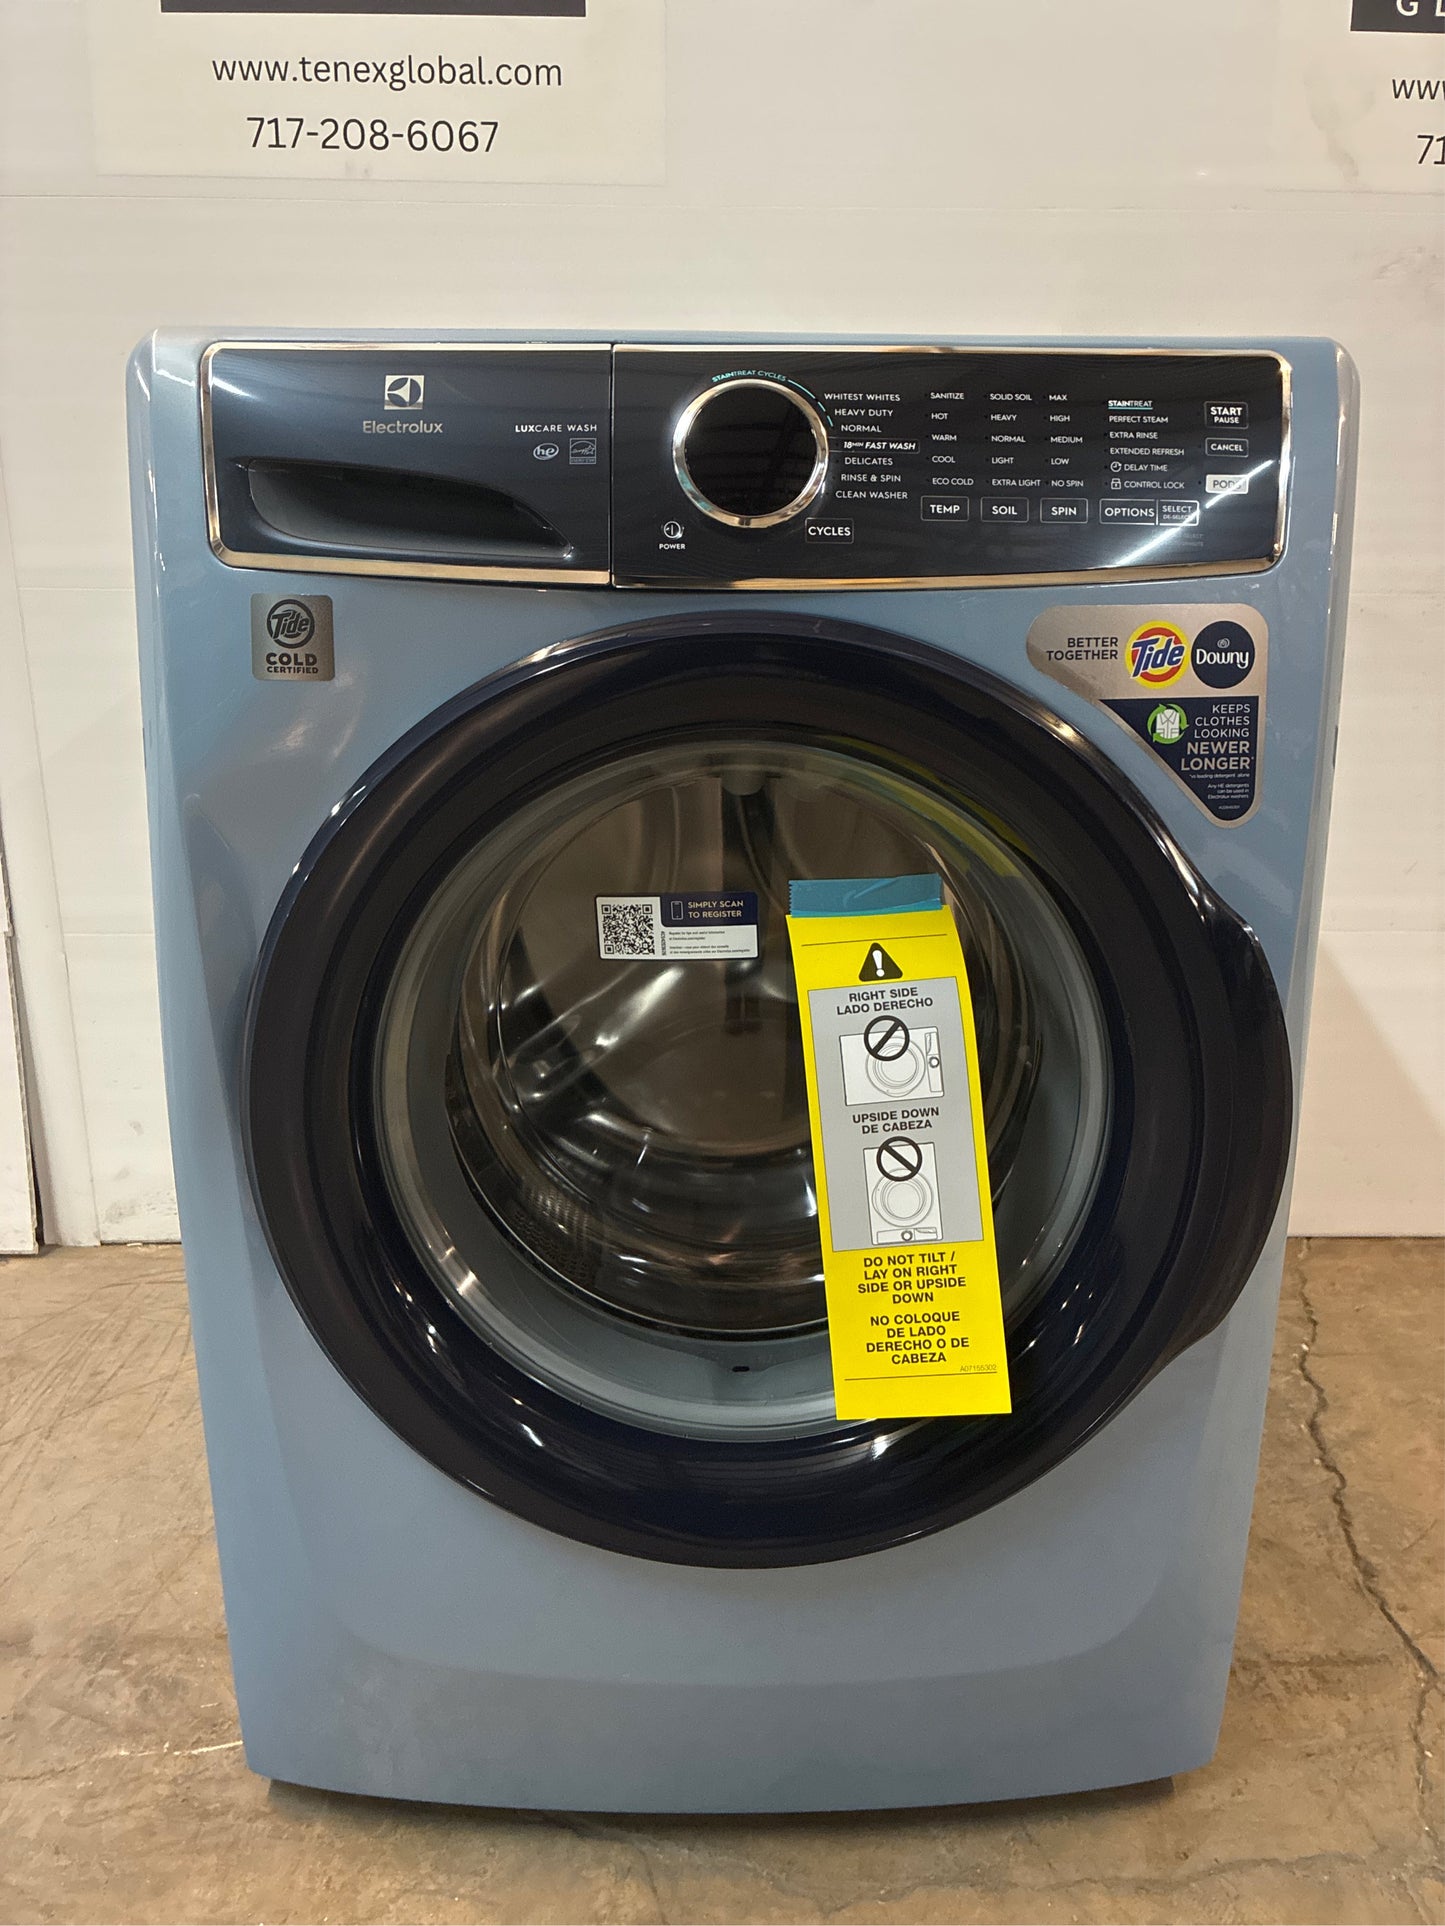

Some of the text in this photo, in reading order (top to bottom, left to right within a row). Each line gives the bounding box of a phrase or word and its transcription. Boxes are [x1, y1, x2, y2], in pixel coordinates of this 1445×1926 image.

[212, 55, 563, 91] www.tenexglobal.com
[1392, 79, 1445, 100] ww
[246, 116, 499, 153] 717-208-6067
[712, 370, 787, 382] STAINTREAT CYCLES
[824, 393, 901, 402] WHITEST WHITES
[930, 392, 965, 400] SANITIZE
[990, 393, 1032, 401] SOLID SOIL
[834, 408, 894, 417] HEAVY DUTY
[1210, 406, 1243, 416] START
[990, 414, 1017, 422] HEAVY
[1050, 414, 1070, 422] HIGH
[1109, 415, 1169, 424] PERFECT STEAM
[1214, 416, 1240, 424] PAUSE
[363, 420, 443, 434] Electrolux
[515, 424, 597, 433] LUXCARE WASH
[841, 424, 882, 433] NORMAL
[991, 435, 1026, 443] NORMAL
[1050, 435, 1083, 443] MEDIUM
[1109, 431, 1159, 440] EXTRA RINSE
[865, 441, 887, 449] FAST
[889, 442, 916, 450] WASH
[1210, 443, 1243, 452] CANCEL
[1110, 447, 1185, 456] EXTENDED REFRESH
[844, 457, 893, 466] DELICATES
[931, 455, 956, 463] COOL
[991, 456, 1014, 465] LIGHT
[1051, 457, 1069, 465] LOW
[1124, 463, 1168, 472] DELAY TIME
[841, 474, 869, 482] RINSE
[879, 474, 901, 482] SPIN
[932, 477, 974, 486] ECO COLD
[1017, 479, 1041, 487] LIGHT
[1051, 479, 1084, 488] NO SPIN
[1124, 480, 1185, 489] CONTROL LOCK
[835, 490, 908, 500] CLEAN WASHER
[930, 504, 960, 514] TEMP
[992, 505, 1018, 515] SOIL
[1051, 506, 1077, 516] SPIN
[1104, 507, 1155, 517] OPTIONS
[1162, 505, 1192, 513] SELECT
[808, 526, 851, 537] CYCLES
[271, 609, 311, 640] Tide
[1067, 637, 1119, 648] BETTER
[266, 652, 318, 666] COLD
[1046, 650, 1118, 661] TOGETHER
[1130, 636, 1185, 679] Tide
[1196, 649, 1249, 669] Downy
[267, 666, 319, 674] CERTIFIED
[1212, 704, 1250, 714] KEEPS
[1195, 716, 1250, 726] CLOTHES
[1194, 728, 1250, 739] LOOKING
[1187, 741, 1250, 755] NEWER
[688, 900, 744, 909] SIMPLY SCAN
[688, 910, 742, 919] TO REGISTER
[849, 987, 918, 1002] RIGHT SIDE
[837, 997, 933, 1015] LADO DERECHO
[852, 1107, 939, 1124] UPSIDE DOWN
[862, 1119, 932, 1135] DE CABEZA
[864, 1251, 956, 1268] DO NOT TILT /
[864, 1264, 957, 1281] LAY ON RIGHT
[857, 1276, 966, 1294] SIDE OR UPSIDE
[892, 1292, 934, 1304] DOWN
[870, 1311, 960, 1326] NO COLOQUE
[887, 1325, 946, 1339] DE LADO
[866, 1337, 970, 1353] DERECHO O DE
[891, 1352, 947, 1365] CABEZA
[959, 1364, 997, 1372] A07155302
